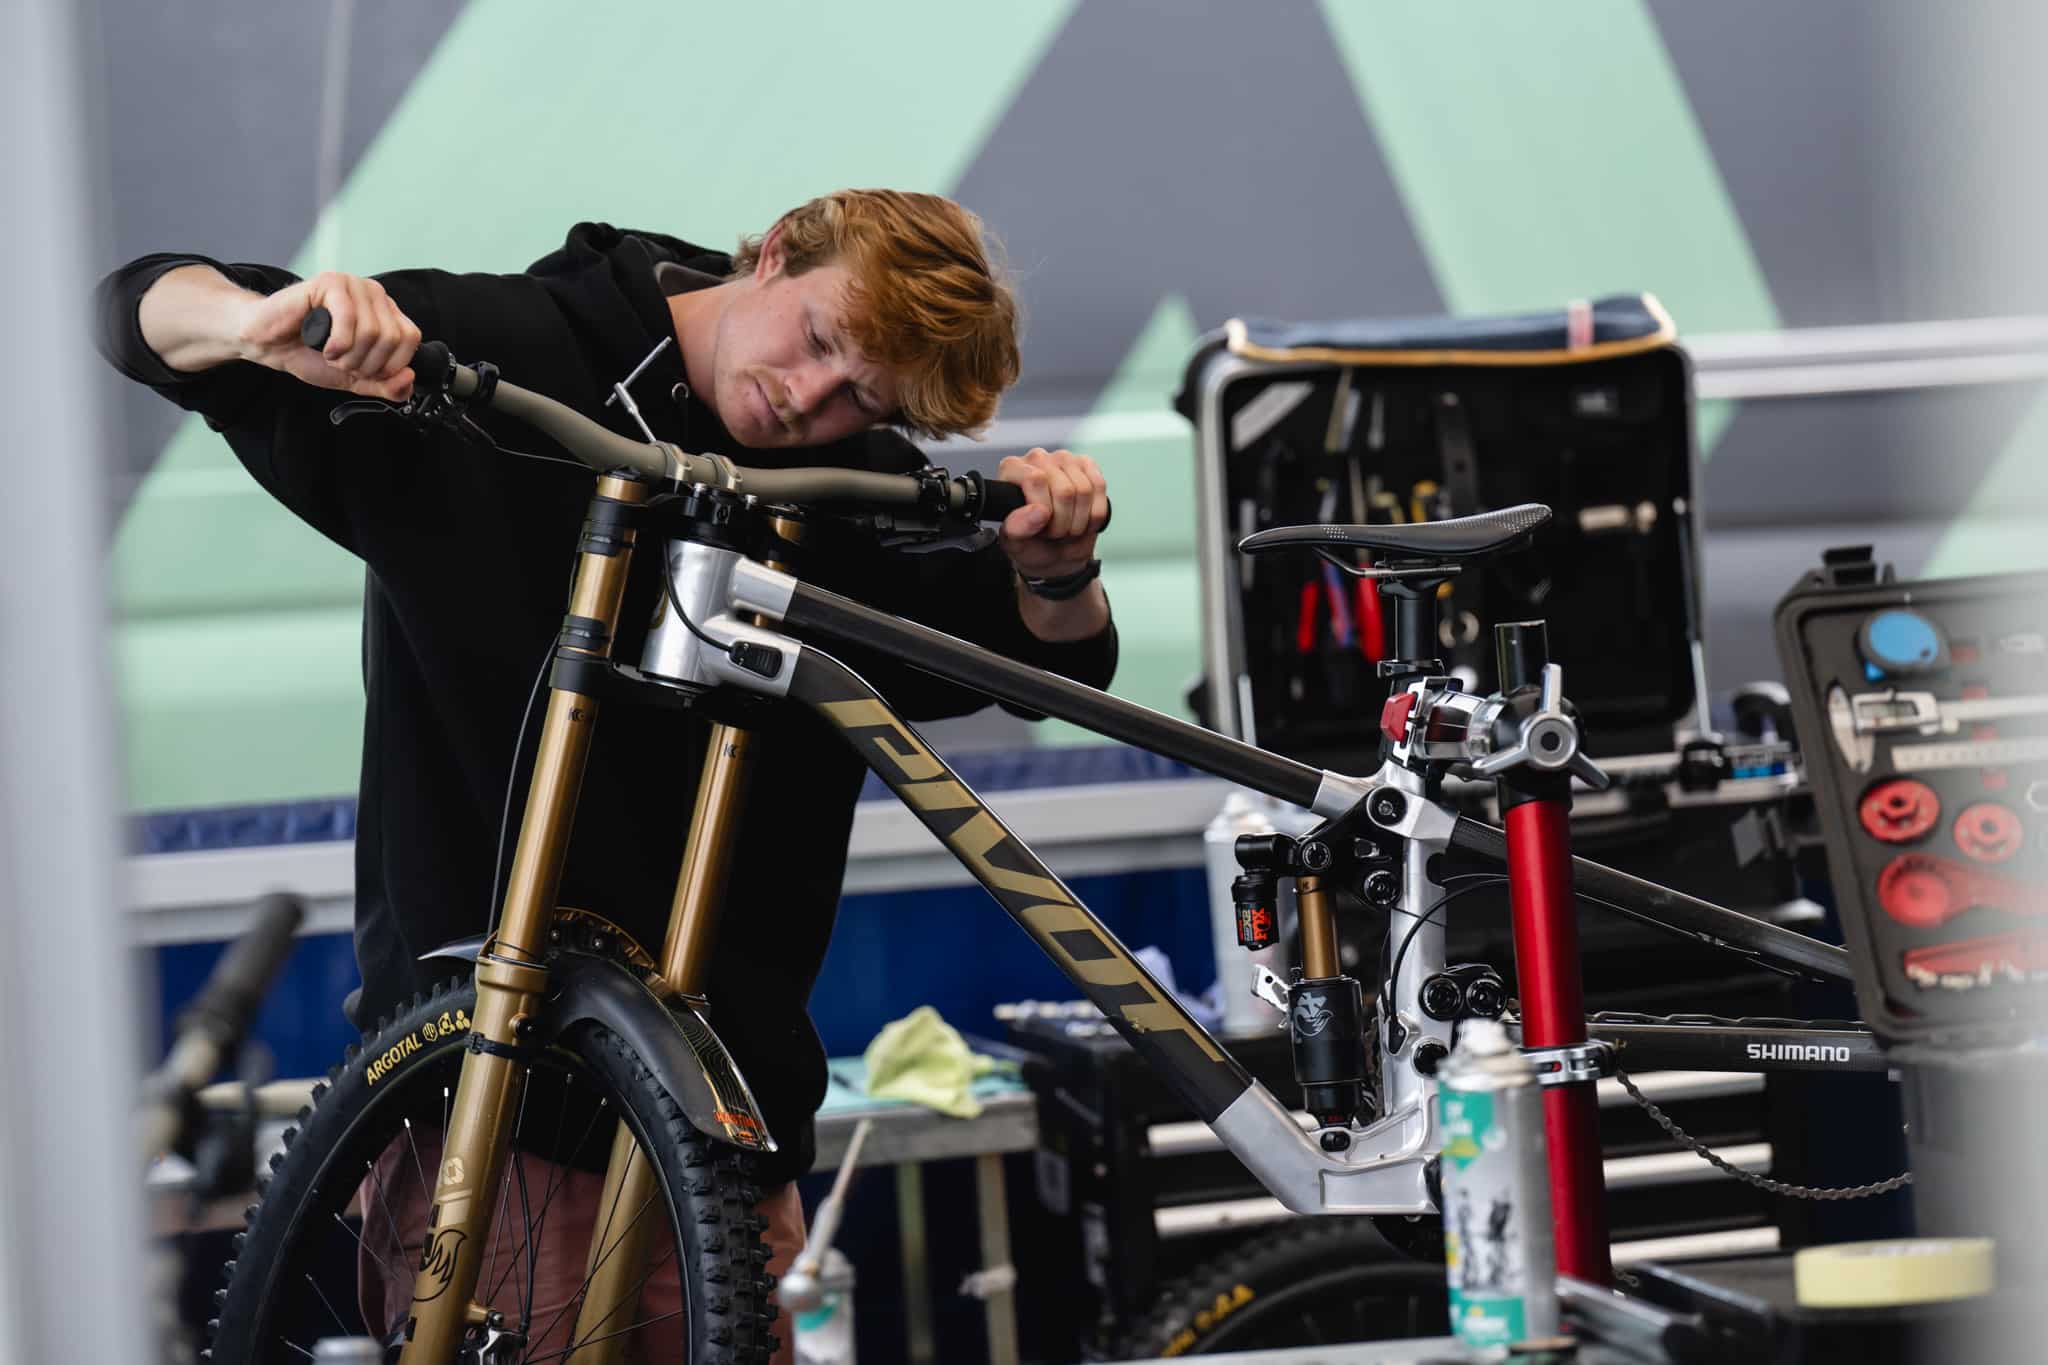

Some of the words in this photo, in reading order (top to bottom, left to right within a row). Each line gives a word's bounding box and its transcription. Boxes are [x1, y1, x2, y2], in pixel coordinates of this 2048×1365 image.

[821, 698, 1225, 1063] PIVOT
[1252, 907, 1270, 941] FOX
[366, 1032, 423, 1087] ARGOTAL
[1746, 1043, 1850, 1062] SHIMANO
